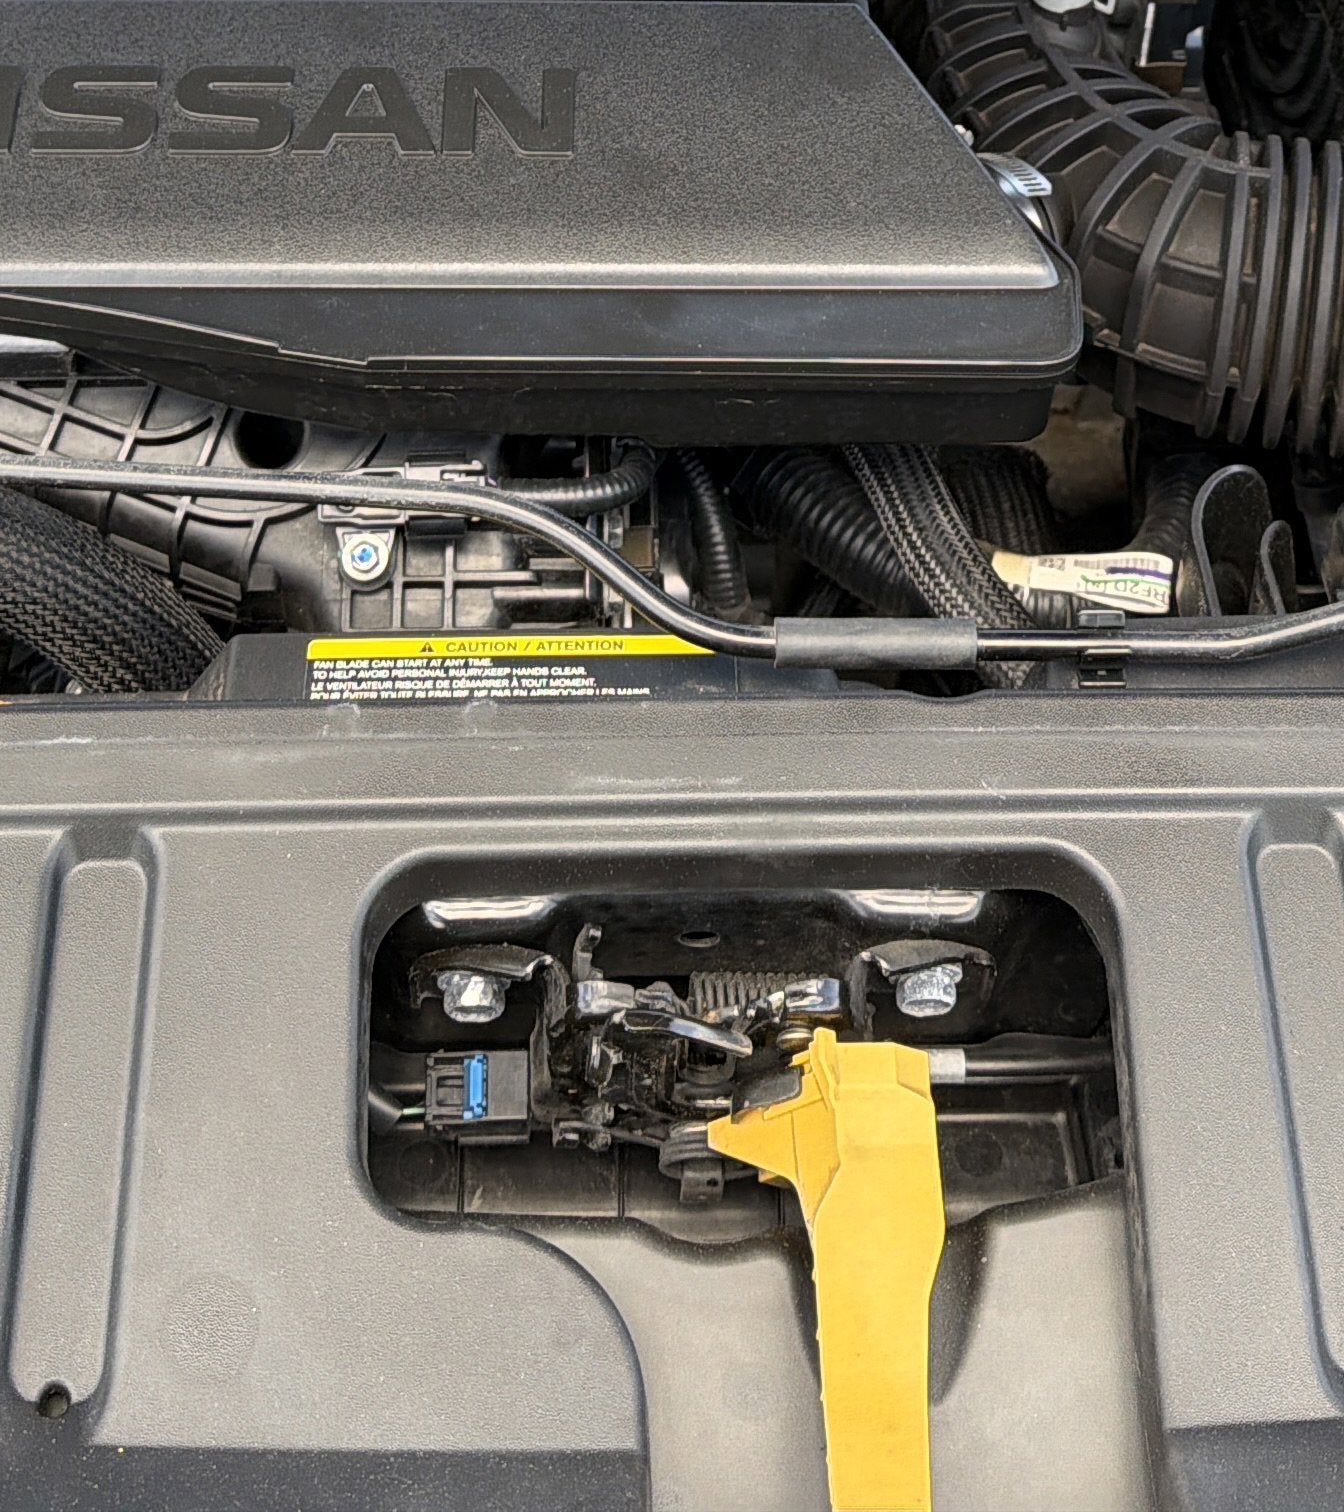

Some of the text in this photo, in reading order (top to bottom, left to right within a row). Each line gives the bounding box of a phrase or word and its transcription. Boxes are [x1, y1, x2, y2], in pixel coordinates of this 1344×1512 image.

[445, 641, 518, 653] CAUTION
[536, 639, 624, 651] ATTENTION
[313, 660, 334, 669] FAN
[336, 660, 369, 669] BLADE
[371, 659, 394, 668] CAN
[396, 659, 428, 668] START
[429, 658, 442, 667] AT
[444, 658, 466, 667] ANY
[312, 670, 328, 679] TO
[329, 670, 356, 679] HELP
[357, 669, 389, 679] AVOID
[391, 669, 447, 678] PERSONAL
[512, 667, 549, 676] HANDS
[311, 681, 323, 691] LE
[326, 680, 393, 690] VENTILATEUR
[394, 680, 433, 690] RISQUE
[436, 679, 450, 688] DE
[520, 679, 548, 688] TOUT
